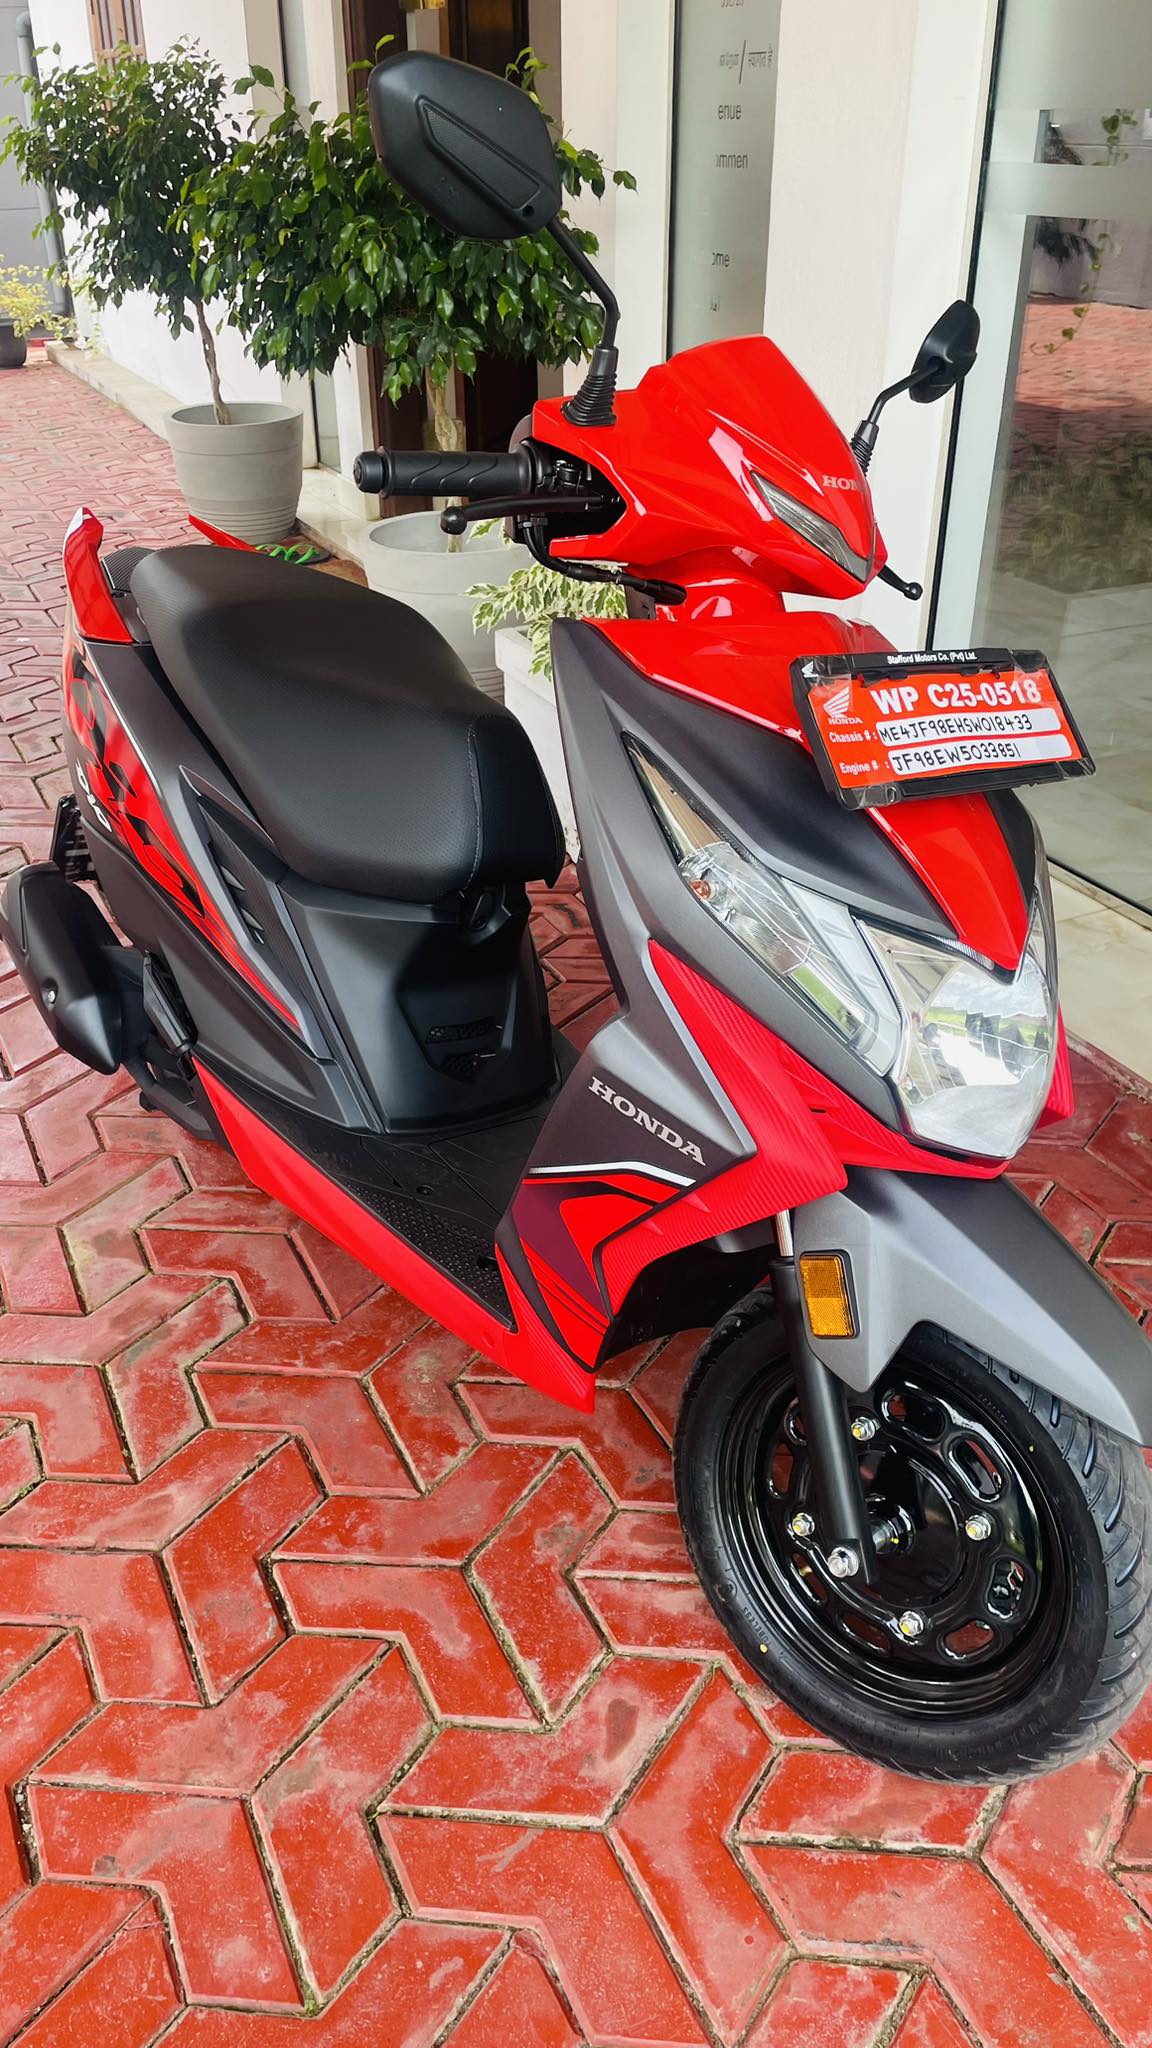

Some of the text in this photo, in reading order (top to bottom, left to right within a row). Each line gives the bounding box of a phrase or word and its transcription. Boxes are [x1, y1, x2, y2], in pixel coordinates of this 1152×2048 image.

[886, 651, 978, 664] Stafford Motors Co. (Pvt) Ltd.
[869, 679, 1042, 714] WP C25-0518
[828, 717, 863, 725] HONDA
[829, 731, 864, 743] Chassis
[839, 762, 871, 776] Engine
[588, 1076, 706, 1166] HONDA
